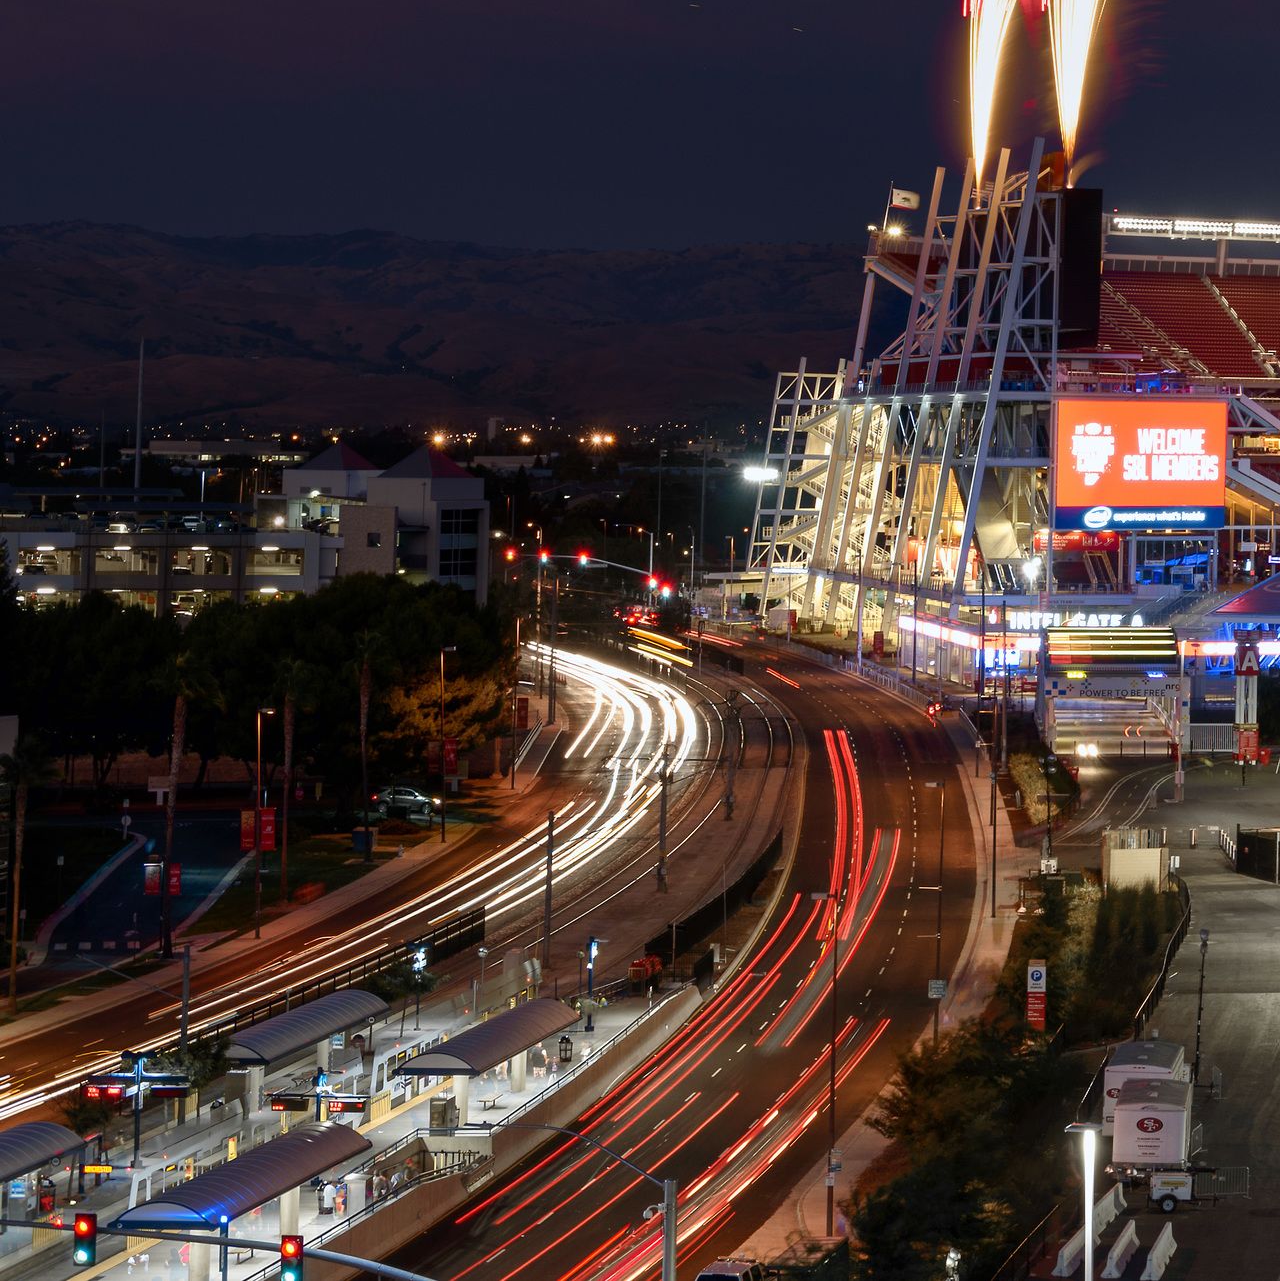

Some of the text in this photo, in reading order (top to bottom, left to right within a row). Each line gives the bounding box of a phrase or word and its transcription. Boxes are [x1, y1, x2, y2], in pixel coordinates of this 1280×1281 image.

[1137, 428, 1206, 455] WELCOME
[1123, 454, 1149, 481] SBL
[1151, 454, 1219, 481] MEMBERS
[1131, 614, 1143, 627] A
[1242, 650, 1259, 671] A
[1079, 689, 1166, 697] POWER TO BE FREE
[1165, 683, 1181, 691] nrg
